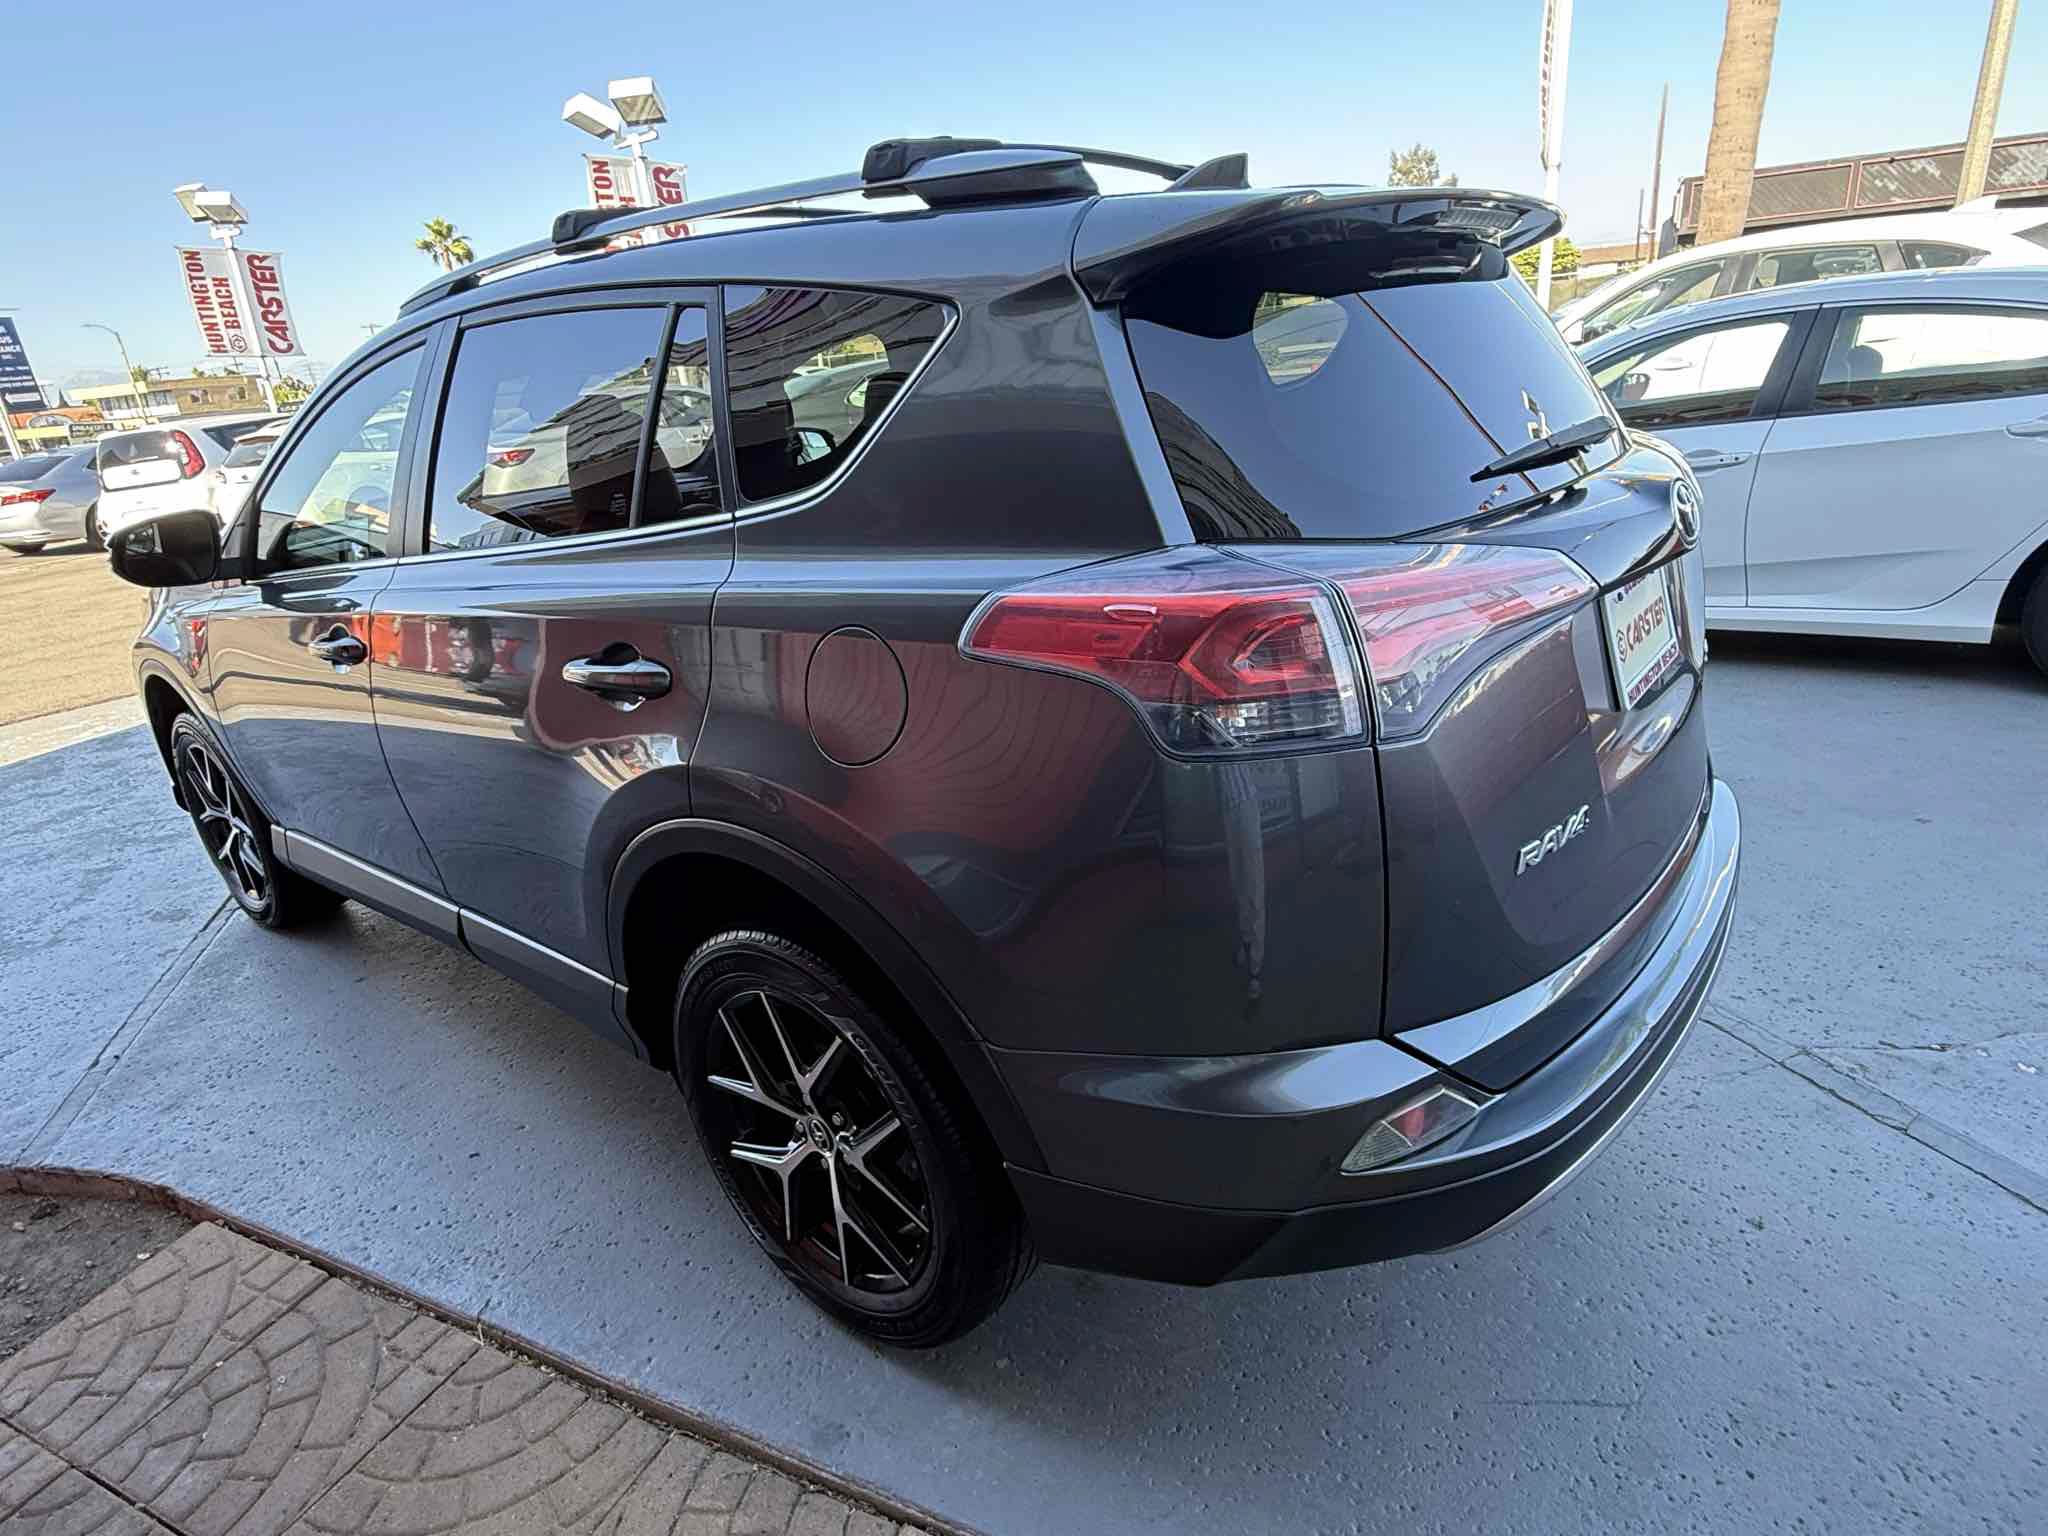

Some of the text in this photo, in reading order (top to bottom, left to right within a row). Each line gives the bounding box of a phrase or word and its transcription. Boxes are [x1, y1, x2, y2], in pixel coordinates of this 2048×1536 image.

[182, 250, 228, 353] HUNTINGTON
[211, 276, 242, 330] BEACH
[246, 254, 294, 354] CARSTER
[1626, 595, 1666, 652] CARSTER
[1516, 804, 1590, 876] RAV4
